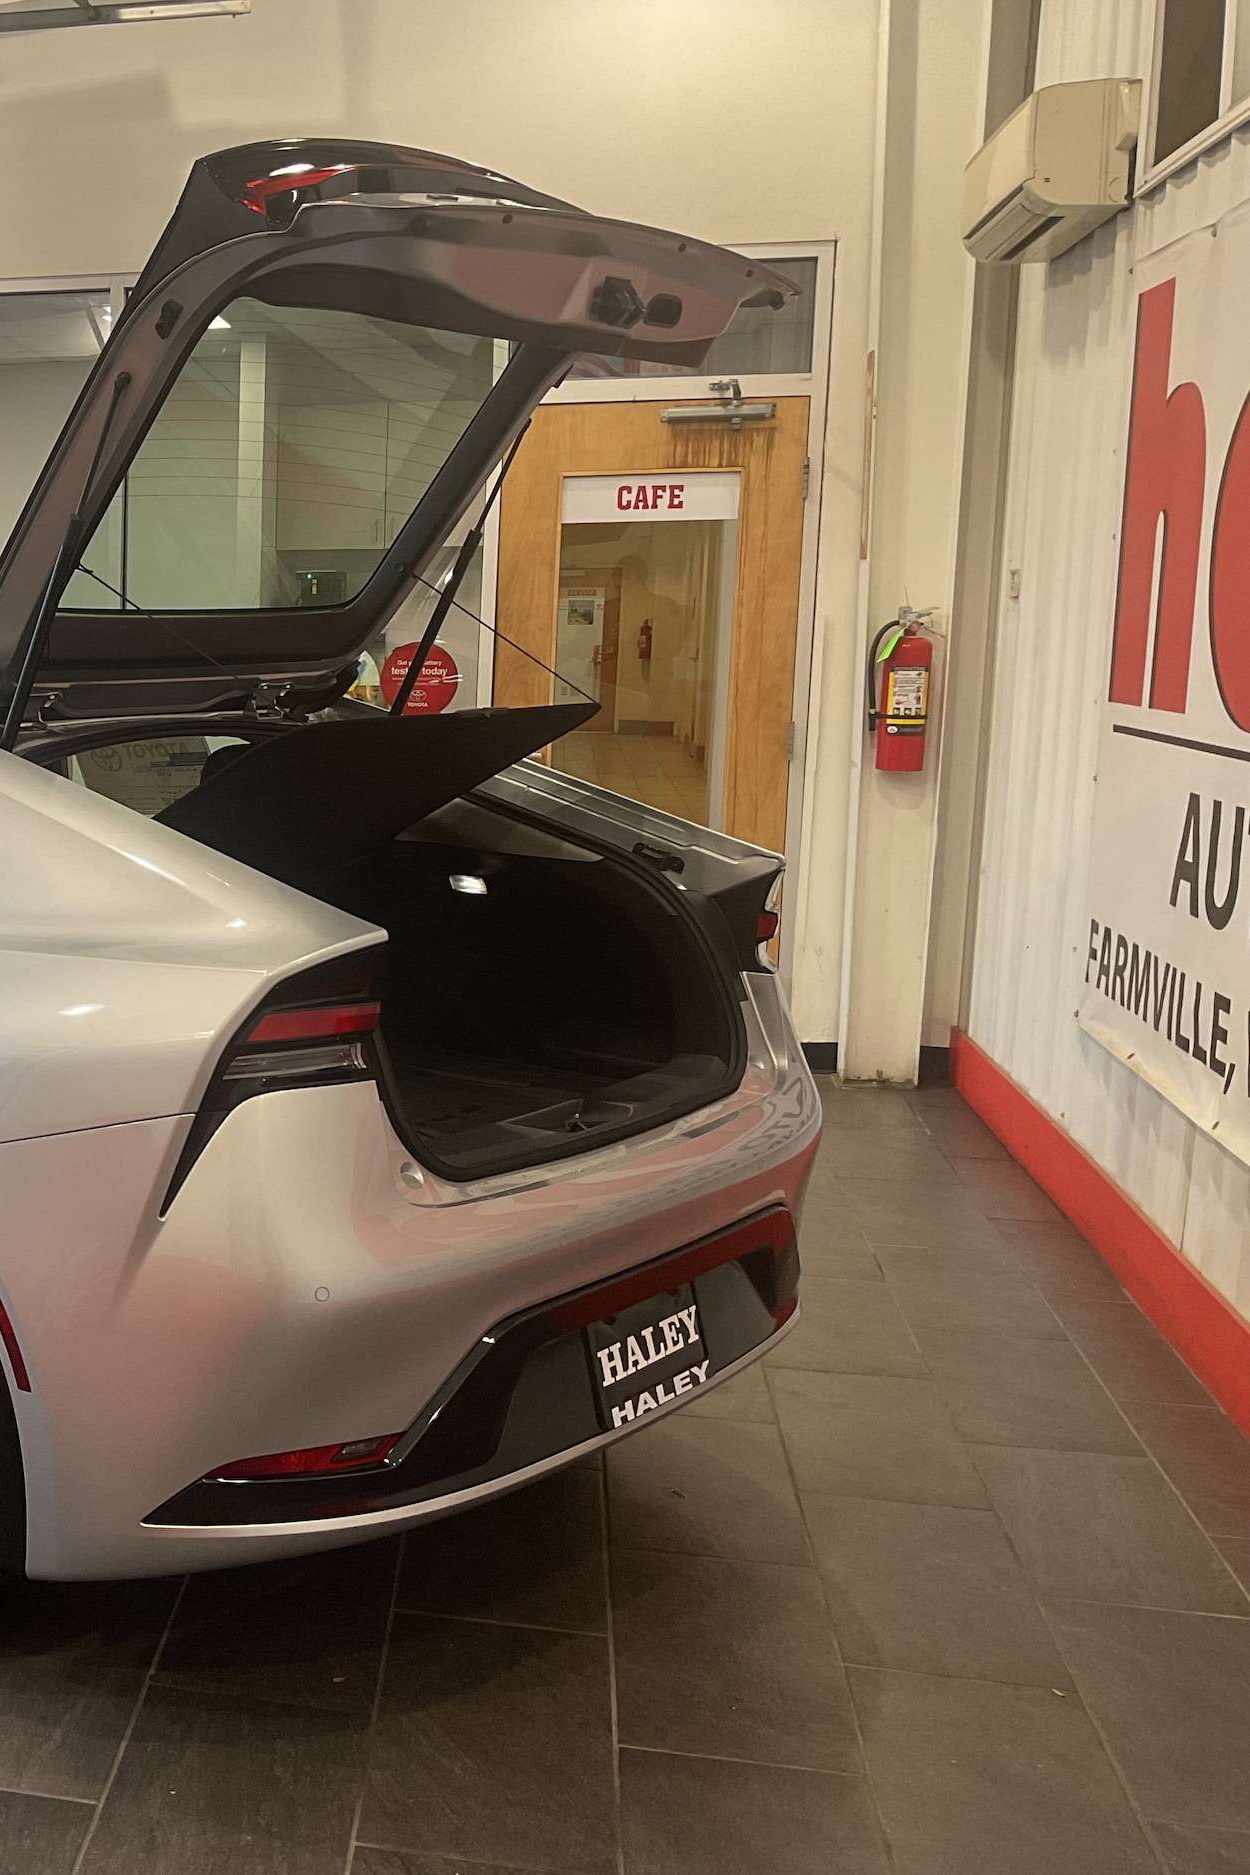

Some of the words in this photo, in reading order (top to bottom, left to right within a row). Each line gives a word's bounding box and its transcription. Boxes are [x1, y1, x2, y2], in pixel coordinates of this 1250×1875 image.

[617, 484, 684, 511] CAFE
[567, 589, 597, 597] SERVICE
[422, 667, 448, 677] today
[122, 742, 188, 759] TOYOTA
[1085, 918, 1236, 1095] FARMVILLE,
[597, 1305, 700, 1388] HALEY
[611, 1359, 710, 1428] HALEY
